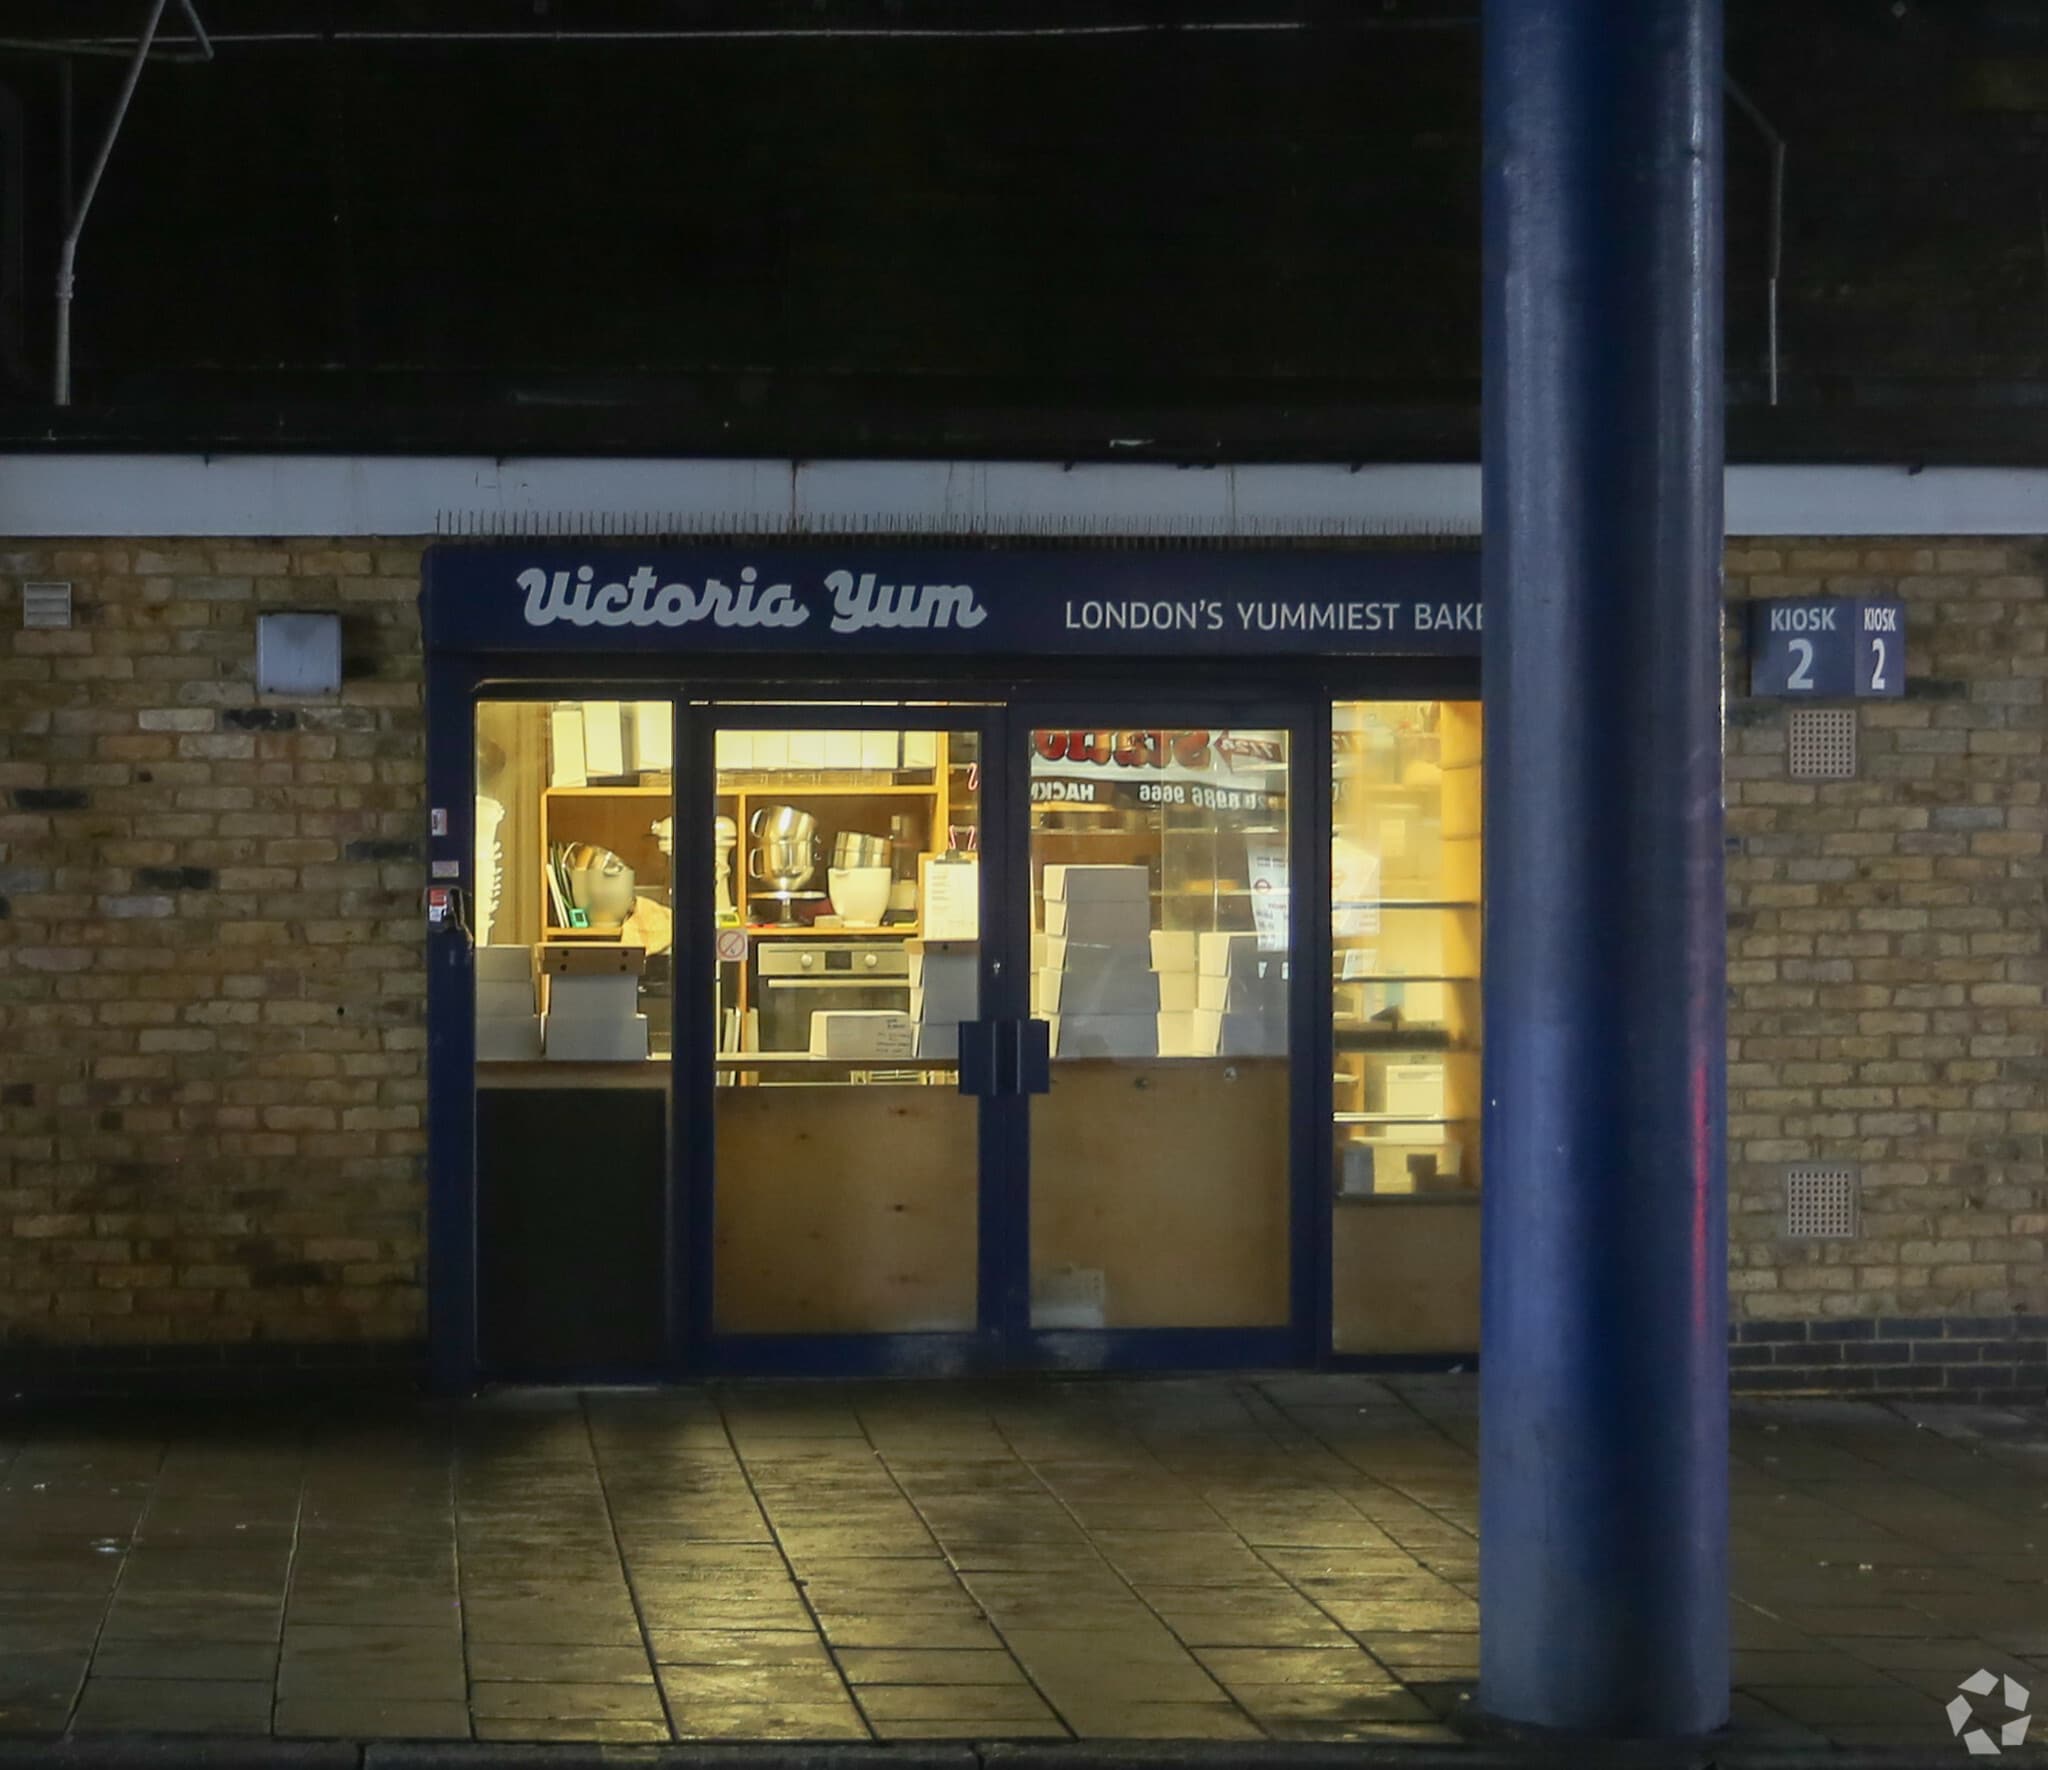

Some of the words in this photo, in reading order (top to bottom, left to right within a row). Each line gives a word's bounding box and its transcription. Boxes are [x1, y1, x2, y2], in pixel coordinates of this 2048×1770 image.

[517, 565, 810, 628] Victoria
[823, 569, 988, 634] Yum
[1065, 600, 1224, 630] LONDON'S
[1236, 602, 1401, 631] YUMMIEST
[1770, 607, 1836, 631] KIOSK
[1863, 607, 1896, 632] KIOSK
[1786, 637, 1815, 690] 2
[1871, 637, 1886, 690] 2
